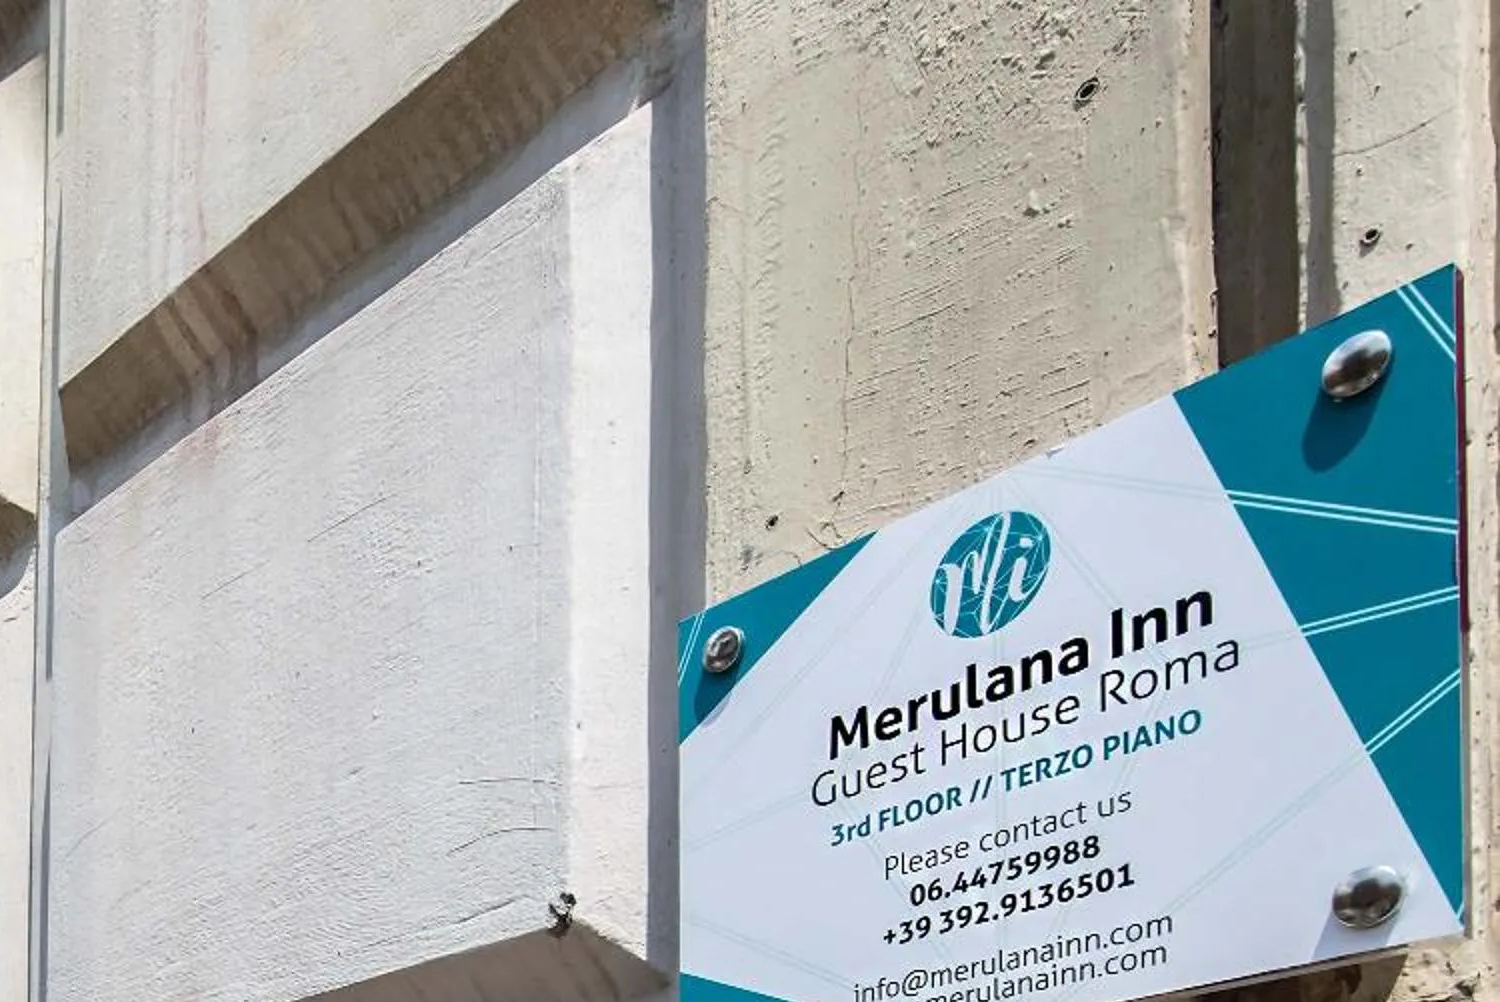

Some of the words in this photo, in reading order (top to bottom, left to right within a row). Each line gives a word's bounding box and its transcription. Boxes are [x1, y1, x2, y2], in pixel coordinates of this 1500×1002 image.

[811, 743, 927, 807] Guest
[940, 695, 1081, 767] House
[1099, 639, 1240, 713] Roma
[829, 637, 1089, 761] Merulana
[1110, 590, 1213, 660] Inn
[830, 813, 871, 847] 3rd
[878, 786, 963, 833] FLOOR
[999, 743, 1094, 793] TERZO
[1103, 709, 1203, 761] PIANO
[885, 841, 970, 881] Please
[979, 801, 1088, 853] contact
[1097, 791, 1132, 819] us
[909, 834, 1101, 907] 06.44759988
[883, 915, 932, 945] +39
[938, 863, 1135, 935] 392.9136501
